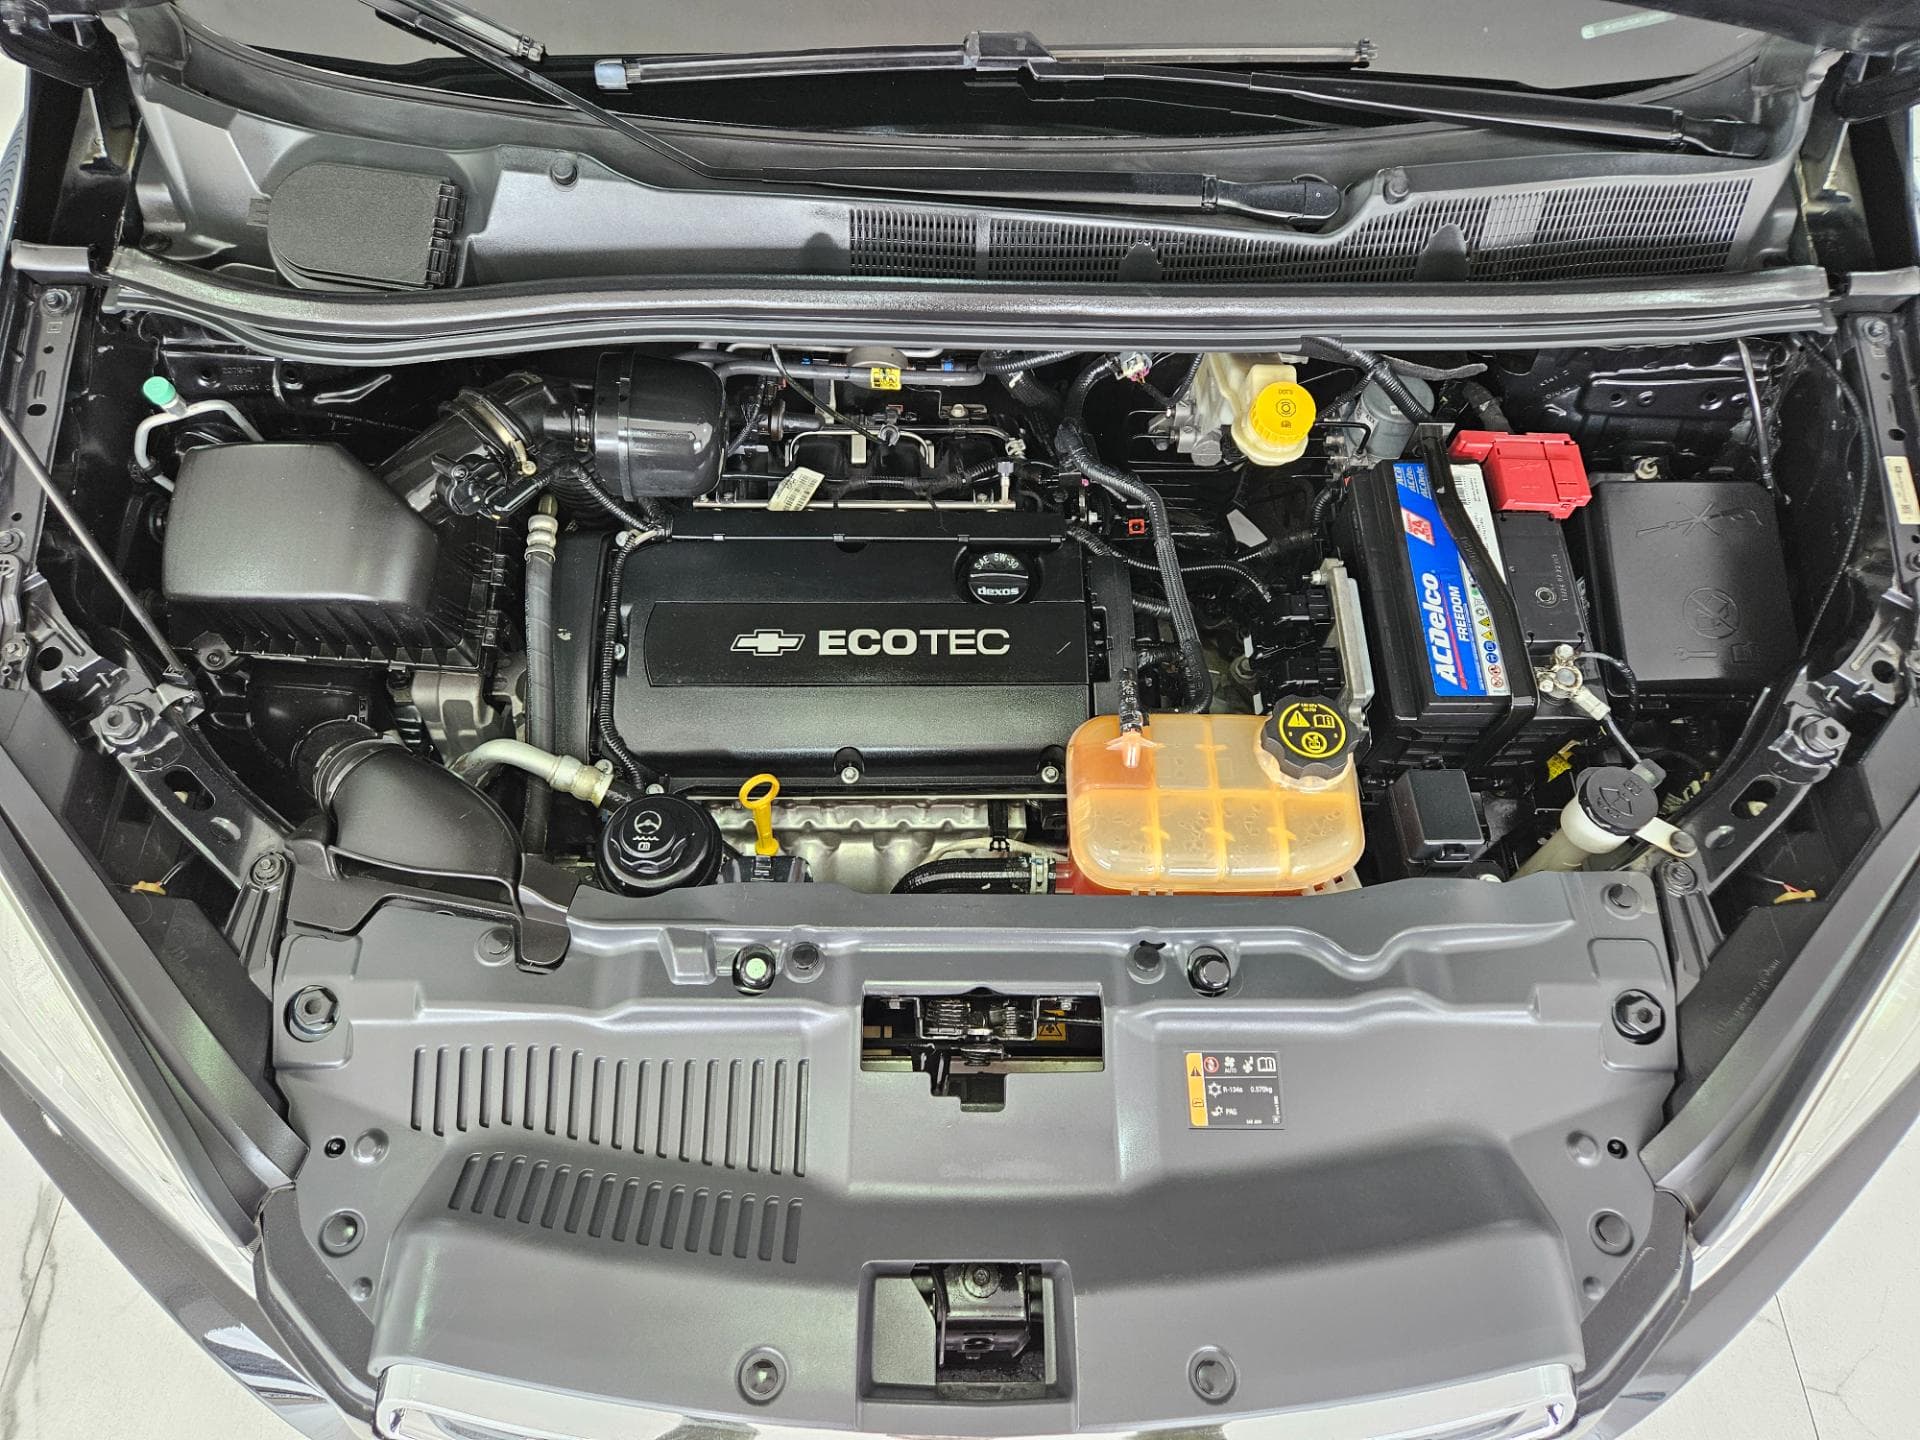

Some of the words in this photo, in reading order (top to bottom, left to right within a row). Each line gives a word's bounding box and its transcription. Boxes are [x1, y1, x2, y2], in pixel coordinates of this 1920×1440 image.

[974, 555, 990, 570] SAE
[993, 552, 1019, 569] 5W-30
[977, 586, 1019, 596] dexos
[1448, 585, 1471, 641] FREEDOM
[818, 628, 1011, 656] ECOTEC
[1421, 572, 1459, 685] ACDelco
